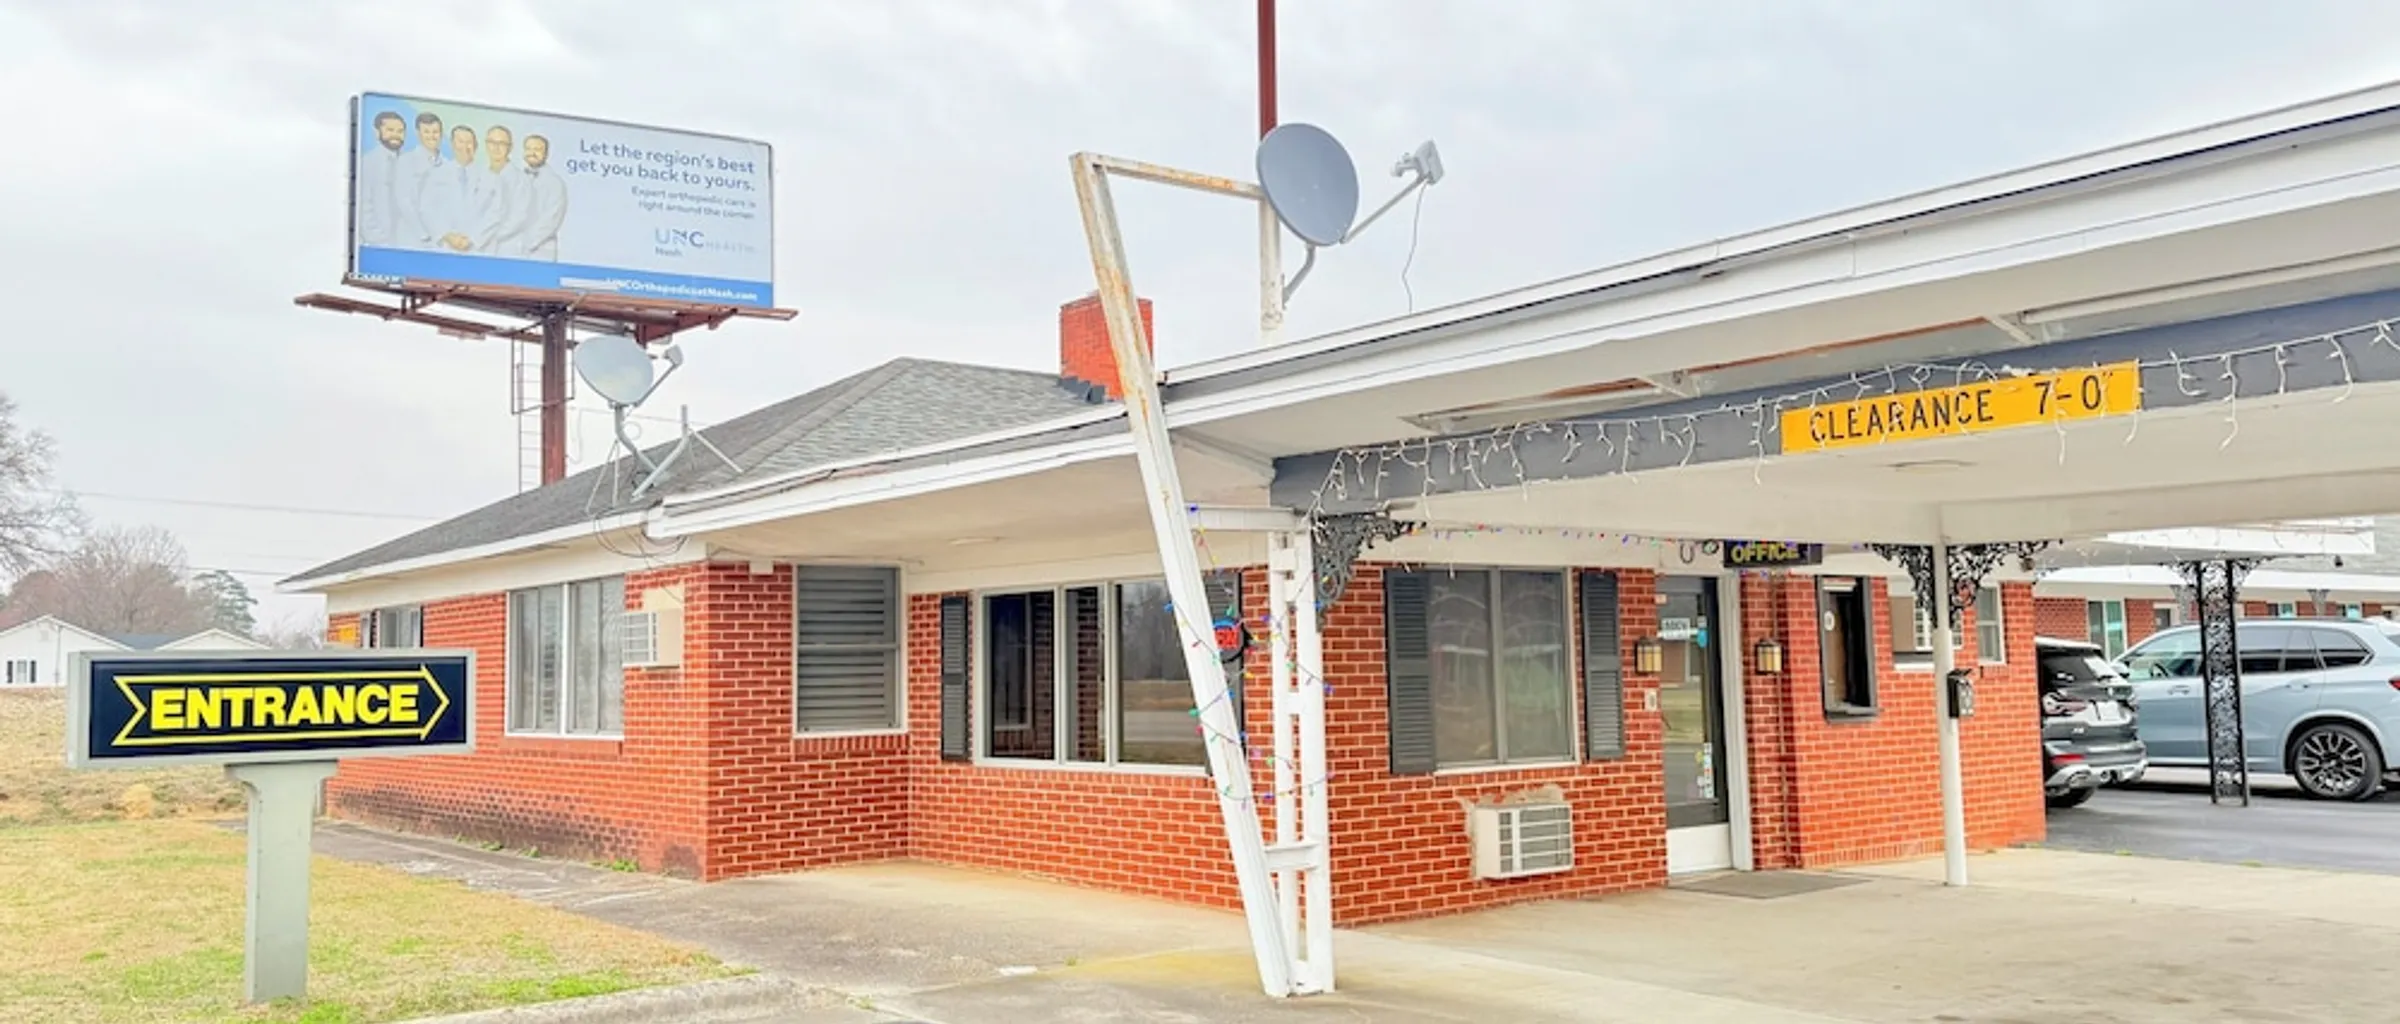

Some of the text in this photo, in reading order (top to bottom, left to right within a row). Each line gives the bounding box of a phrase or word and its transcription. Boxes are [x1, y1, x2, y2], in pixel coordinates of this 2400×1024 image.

[580, 139, 755, 174] Let the region's best
[566, 158, 755, 192] get you back to yours.
[631, 186, 666, 200] Expert
[667, 190, 723, 205] orthopedic
[725, 197, 746, 207] care
[638, 199, 663, 212] right
[665, 202, 702, 214] around
[703, 205, 721, 216] the
[654, 227, 705, 248] UNC
[655, 246, 684, 257] Nash
[1810, 389, 1995, 443] CLEARANCE
[1730, 542, 1799, 564] OFFICE
[150, 683, 420, 730] ENTRANCE
